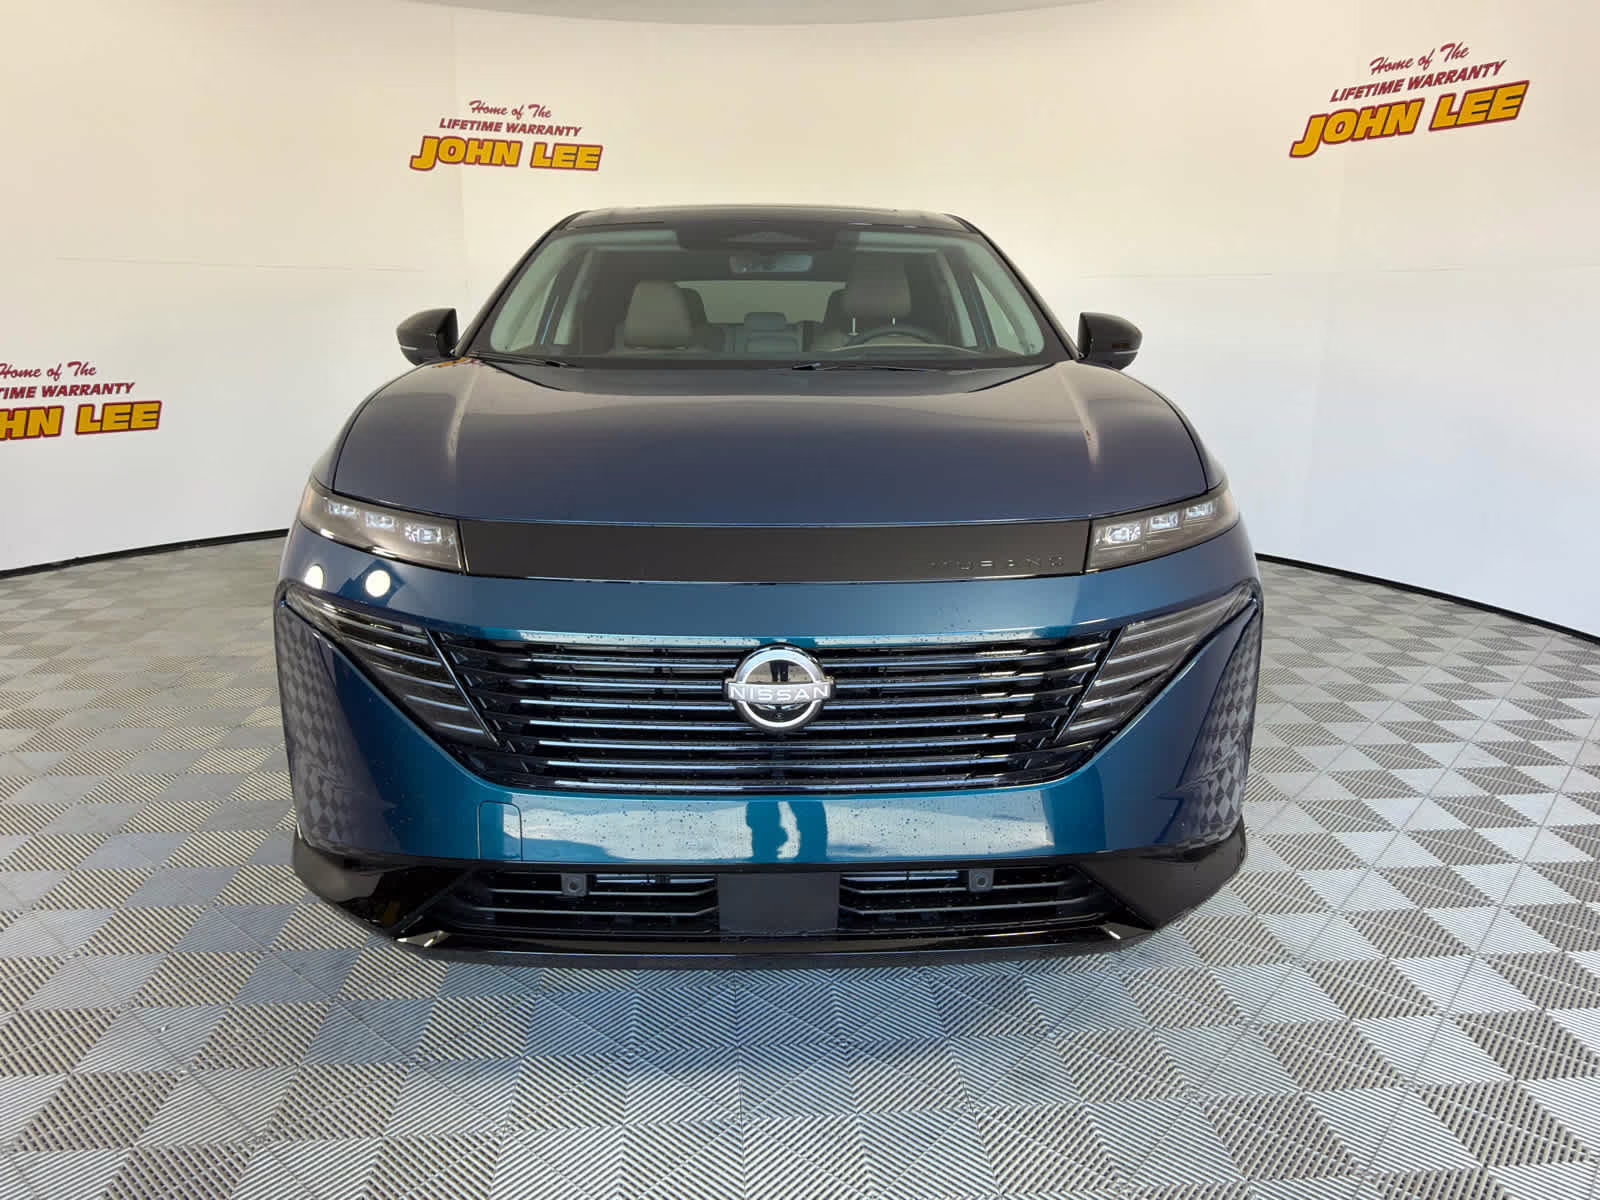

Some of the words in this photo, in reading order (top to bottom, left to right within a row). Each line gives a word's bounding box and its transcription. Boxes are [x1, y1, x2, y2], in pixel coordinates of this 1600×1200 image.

[1369, 56, 1414, 75] Home
[1417, 48, 1435, 71] of
[1440, 41, 1470, 62] The
[1330, 78, 1405, 102] LIFETIME
[1407, 59, 1507, 90] WARRANTY
[468, 100, 508, 116] Home
[511, 105, 526, 120] of
[528, 104, 552, 119] The
[1289, 97, 1426, 158] JOHN
[1428, 79, 1530, 132] LEE
[439, 118, 503, 132] LIFETIME
[506, 122, 582, 137] WARRANTY
[409, 135, 523, 172] JOHN
[529, 141, 604, 172] LEE
[0, 362, 42, 379] Home
[46, 363, 62, 381] of
[67, 361, 97, 377] The
[41, 382, 135, 398] WARRANTY
[75, 400, 162, 435] LEE
[729, 685, 829, 701] NISSAN
